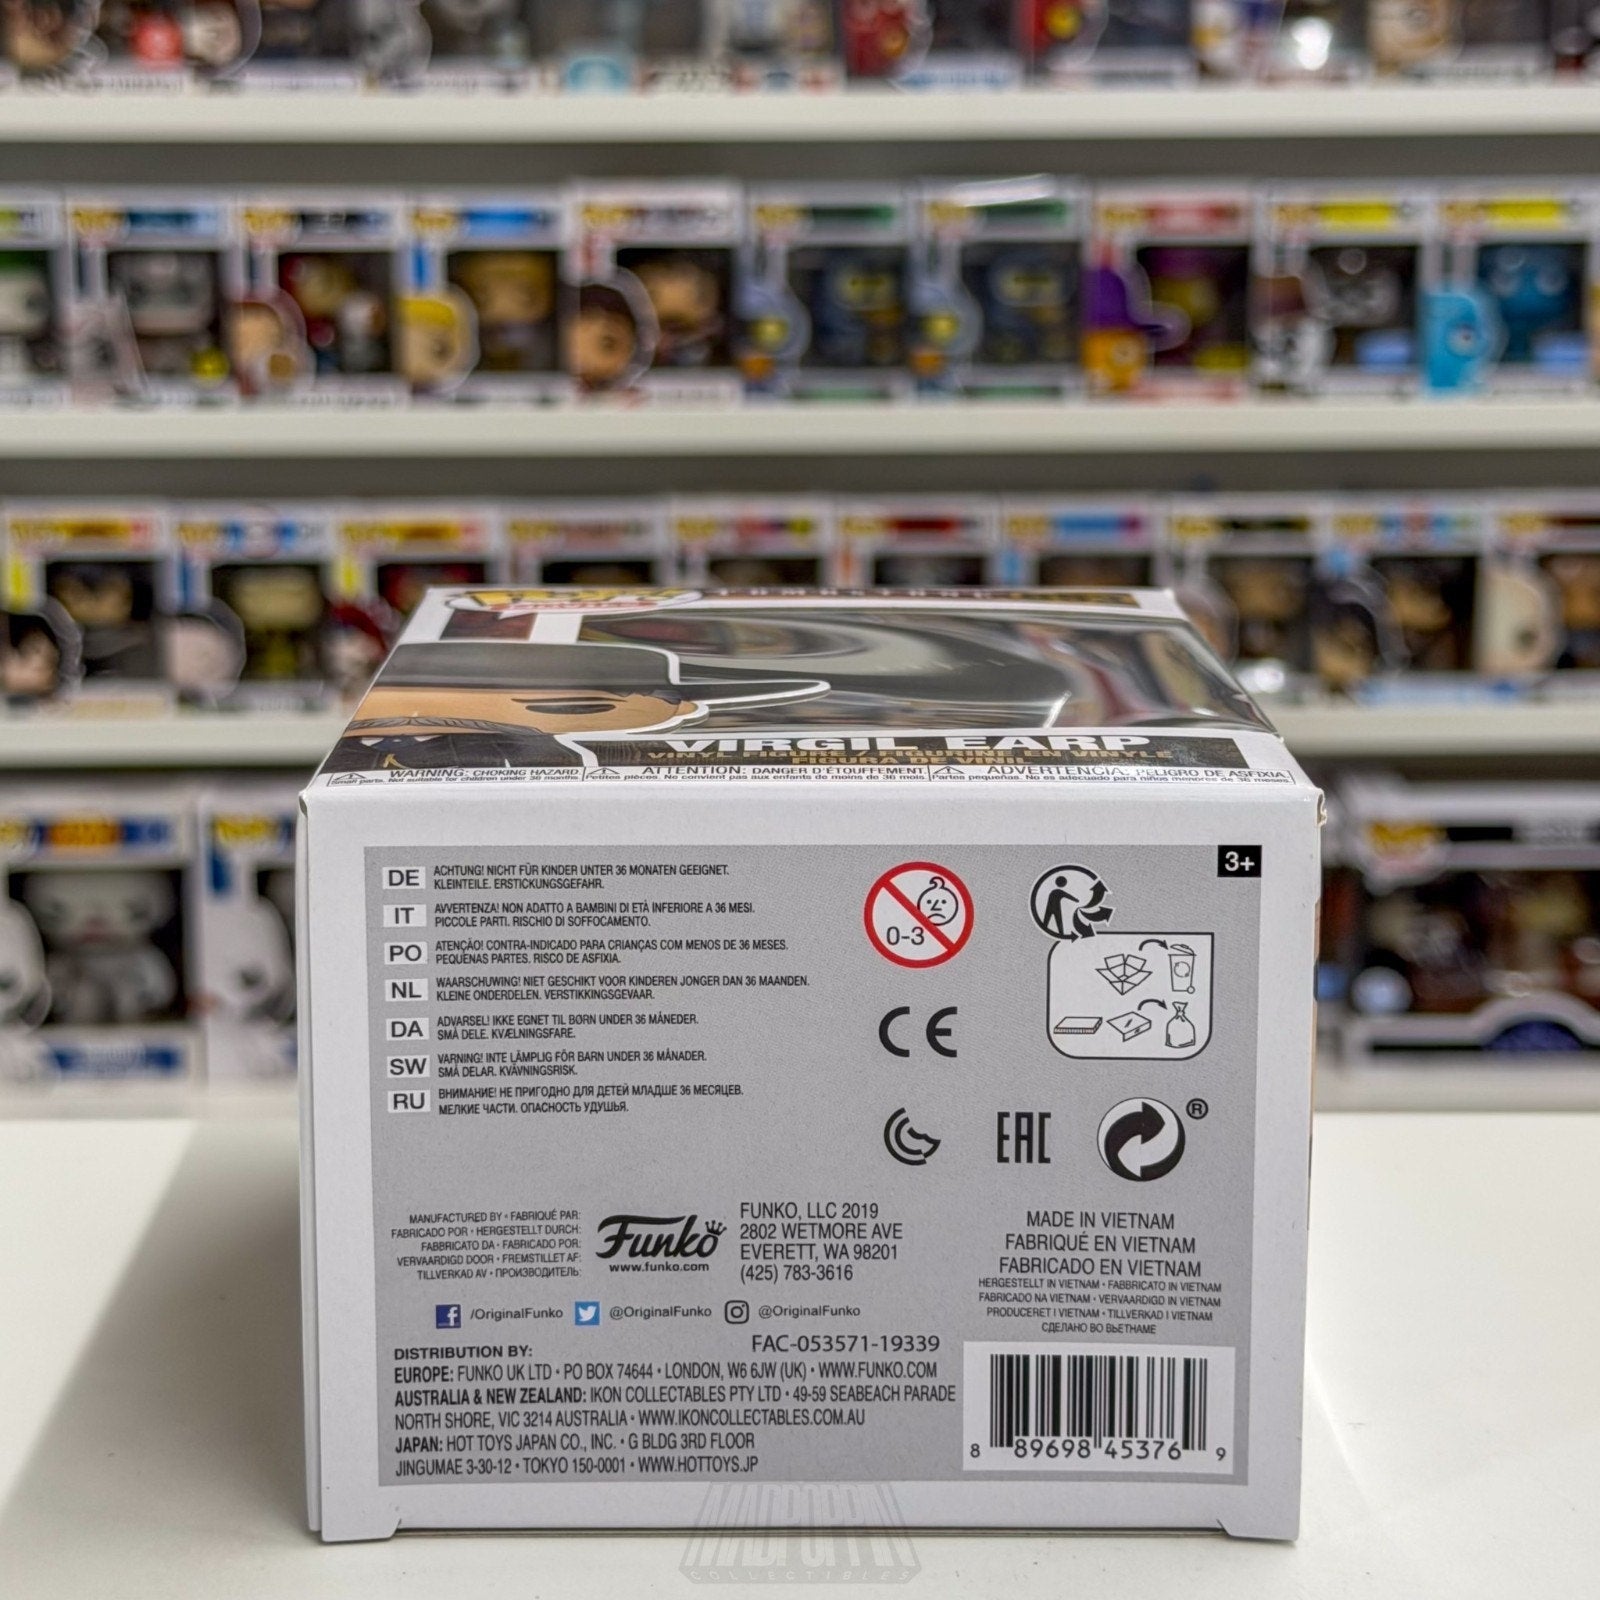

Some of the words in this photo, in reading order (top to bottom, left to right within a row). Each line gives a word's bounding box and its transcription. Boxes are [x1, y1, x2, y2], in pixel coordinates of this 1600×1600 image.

[665, 737, 918, 752] VIRGIL
[945, 736, 1150, 750] EARP
[389, 769, 469, 778] WARNING:
[472, 768, 526, 776] CHOKING
[642, 766, 746, 774] ATTENTION:
[1204, 769, 1224, 777] DE
[433, 865, 484, 876] ACHTUNG!
[486, 865, 516, 876] NICHT
[518, 862, 539, 876] FÜR
[541, 865, 578, 876] KINDER
[580, 864, 613, 876] UNTER
[615, 864, 627, 876] 36
[629, 864, 677, 876] MONATEN
[678, 864, 729, 876] GEEIGNET.
[1224, 852, 1255, 871] 3+
[388, 869, 420, 886] DE
[434, 879, 491, 890] KLEINTEILE.
[493, 878, 604, 890] ERSTICKUNGSGEFAHR.
[394, 907, 414, 924] IT
[886, 927, 925, 945] 0-3
[389, 945, 422, 962] PO
[391, 982, 422, 998] NL
[436, 991, 471, 1001] KLEINE
[472, 990, 541, 1001] ONDERDELEN.
[543, 989, 655, 1001] VERSTIKKINGSGEVAAR.
[437, 1015, 490, 1027] ADVARSEL!
[492, 1015, 515, 1027] IKKE
[517, 1015, 549, 1027] EGNET
[551, 1015, 566, 1026] TIL
[568, 1014, 596, 1026] BØRN
[598, 1014, 633, 1026] UNDER
[634, 1014, 646, 1025] 36
[648, 1011, 699, 1025] MÅNEDER.
[391, 1021, 423, 1038] DA
[437, 1026, 459, 1040] SMÅ
[461, 1029, 489, 1040] DELE.
[491, 1028, 576, 1040] KVÆLNINGSFARE.
[390, 1058, 427, 1075] SW
[393, 1092, 425, 1109] RU
[438, 1103, 480, 1115] МЕЛКИЕ
[482, 1103, 518, 1115] ЧАСТИ.
[520, 1102, 582, 1114] ОПАСНОСТЬ
[583, 1101, 629, 1115] УДУШЬЯ.
[489, 1212, 502, 1223] BY
[510, 1208, 557, 1222] FABRIQUÉ
[559, 1210, 580, 1221] PAR:
[740, 1203, 801, 1221] FUNKO,
[807, 1203, 837, 1218] LLC
[841, 1203, 878, 1218] 2019
[1026, 1211, 1074, 1227] MADE
[1079, 1212, 1095, 1227] IN
[1100, 1213, 1174, 1229] VIETNAM
[596, 1214, 722, 1259] Funko
[740, 1224, 777, 1239] 2802
[781, 1223, 867, 1239] WETMORE
[871, 1223, 902, 1239] AVE
[1005, 1231, 1089, 1251] FABRIQUÉ
[1094, 1236, 1116, 1252] EN
[1121, 1236, 1195, 1253] VIETNAM
[740, 1245, 818, 1262] EVERETT,
[823, 1244, 849, 1260] WA
[853, 1244, 897, 1260] 98201
[609, 1262, 709, 1272] www.funko.com
[740, 1264, 778, 1283] (425)
[783, 1265, 853, 1280] 783-3616
[999, 1257, 1095, 1274] FABRICADO
[1099, 1259, 1122, 1275] EN
[1127, 1260, 1201, 1276] VIETNAM
[978, 1278, 1044, 1290] HERGESTELLT
[1058, 1280, 1100, 1290] VIETNAM
[1107, 1281, 1166, 1292] FABBRICATO
[1179, 1282, 1222, 1292] VIETNAM
[470, 1308, 563, 1321] /OriginalFunko
[609, 1306, 712, 1320] @OriginalFunko
[758, 1305, 860, 1319] @OriginalFunko
[1041, 1322, 1088, 1335] СДЕЛАНО
[1105, 1323, 1156, 1333] ВЬЕТНАМЕ
[394, 1346, 503, 1359] DISTRIBUTION
[507, 1345, 532, 1357] BY:
[752, 1335, 940, 1353] FAC-053571-19339
[394, 1366, 454, 1383] EUROPE:
[457, 1365, 503, 1381] FUNKO
[506, 1365, 525, 1381] UK
[528, 1364, 552, 1380] LTD
[563, 1363, 583, 1380] PO
[586, 1363, 613, 1379] BOX
[618, 1363, 653, 1379] 74644
[665, 1362, 724, 1382] LONDON,
[727, 1362, 747, 1378] W6
[750, 1362, 776, 1378] 6JW
[779, 1362, 807, 1381] (UK)
[818, 1362, 937, 1378] WWW.FUNKO.COM
[394, 1390, 470, 1406] AUSTRALIA
[473, 1389, 483, 1405] &
[486, 1388, 516, 1404] NEW
[519, 1387, 586, 1403] ZEALAND:
[590, 1386, 622, 1403] IKON
[625, 1386, 726, 1402] COLLECTABLES
[729, 1386, 754, 1401] PTY
[757, 1386, 781, 1402] LTD
[792, 1386, 826, 1402] 49-59
[829, 1385, 900, 1401] SEABEACH
[903, 1385, 956, 1401] PARADE
[394, 1413, 441, 1430] NORTH
[444, 1412, 494, 1428] SHORE,
[498, 1411, 520, 1427] VIC
[523, 1411, 552, 1427] 3214
[555, 1410, 628, 1426] AUSTRALIA
[638, 1409, 865, 1425] WWW.IKONCOLLECTABLES.COM.AU
[395, 1437, 443, 1452] JAPAN:
[446, 1435, 472, 1451] HOT
[479, 1435, 512, 1451] TOYS
[515, 1434, 557, 1450] JAPAN
[560, 1433, 587, 1450] CO.,
[590, 1433, 616, 1449] INC.
[628, 1433, 638, 1449] G
[642, 1433, 677, 1449] BLDG
[680, 1433, 707, 1449] 3RD
[710, 1432, 755, 1449] FLOOR
[970, 1443, 980, 1458] 8
[1014, 1439, 1091, 1459] 89698
[1104, 1440, 1182, 1460] 45376
[1215, 1447, 1226, 1461] 9
[395, 1459, 463, 1476] JINGUMAE
[466, 1458, 512, 1474] 3-30-12
[525, 1457, 568, 1473] TOKYO
[572, 1457, 625, 1473] 150-0001
[637, 1456, 758, 1472] WWW.HOTTOYS.JP
